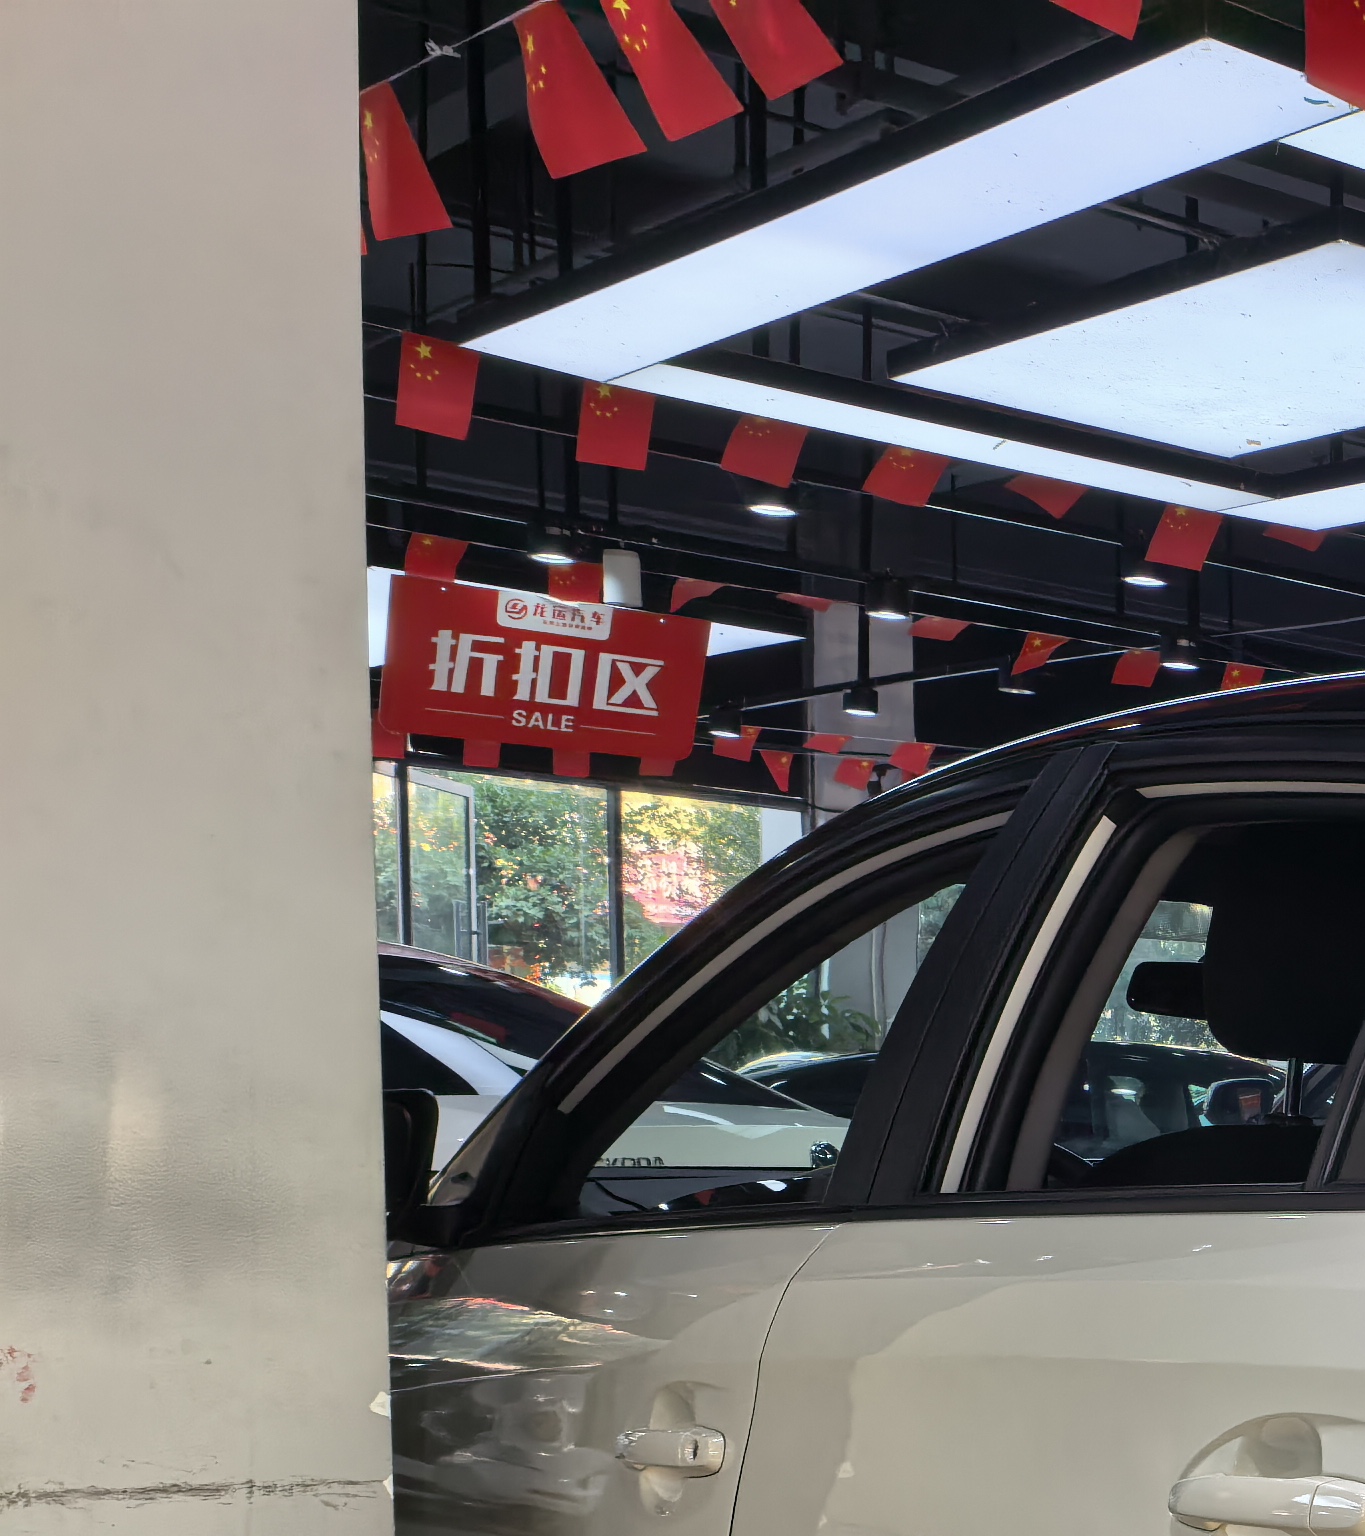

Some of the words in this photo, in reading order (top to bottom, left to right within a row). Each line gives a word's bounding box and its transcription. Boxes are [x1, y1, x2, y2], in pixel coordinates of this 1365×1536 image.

[428, 629, 665, 717] 折扣区
[511, 709, 575, 732] SALE
